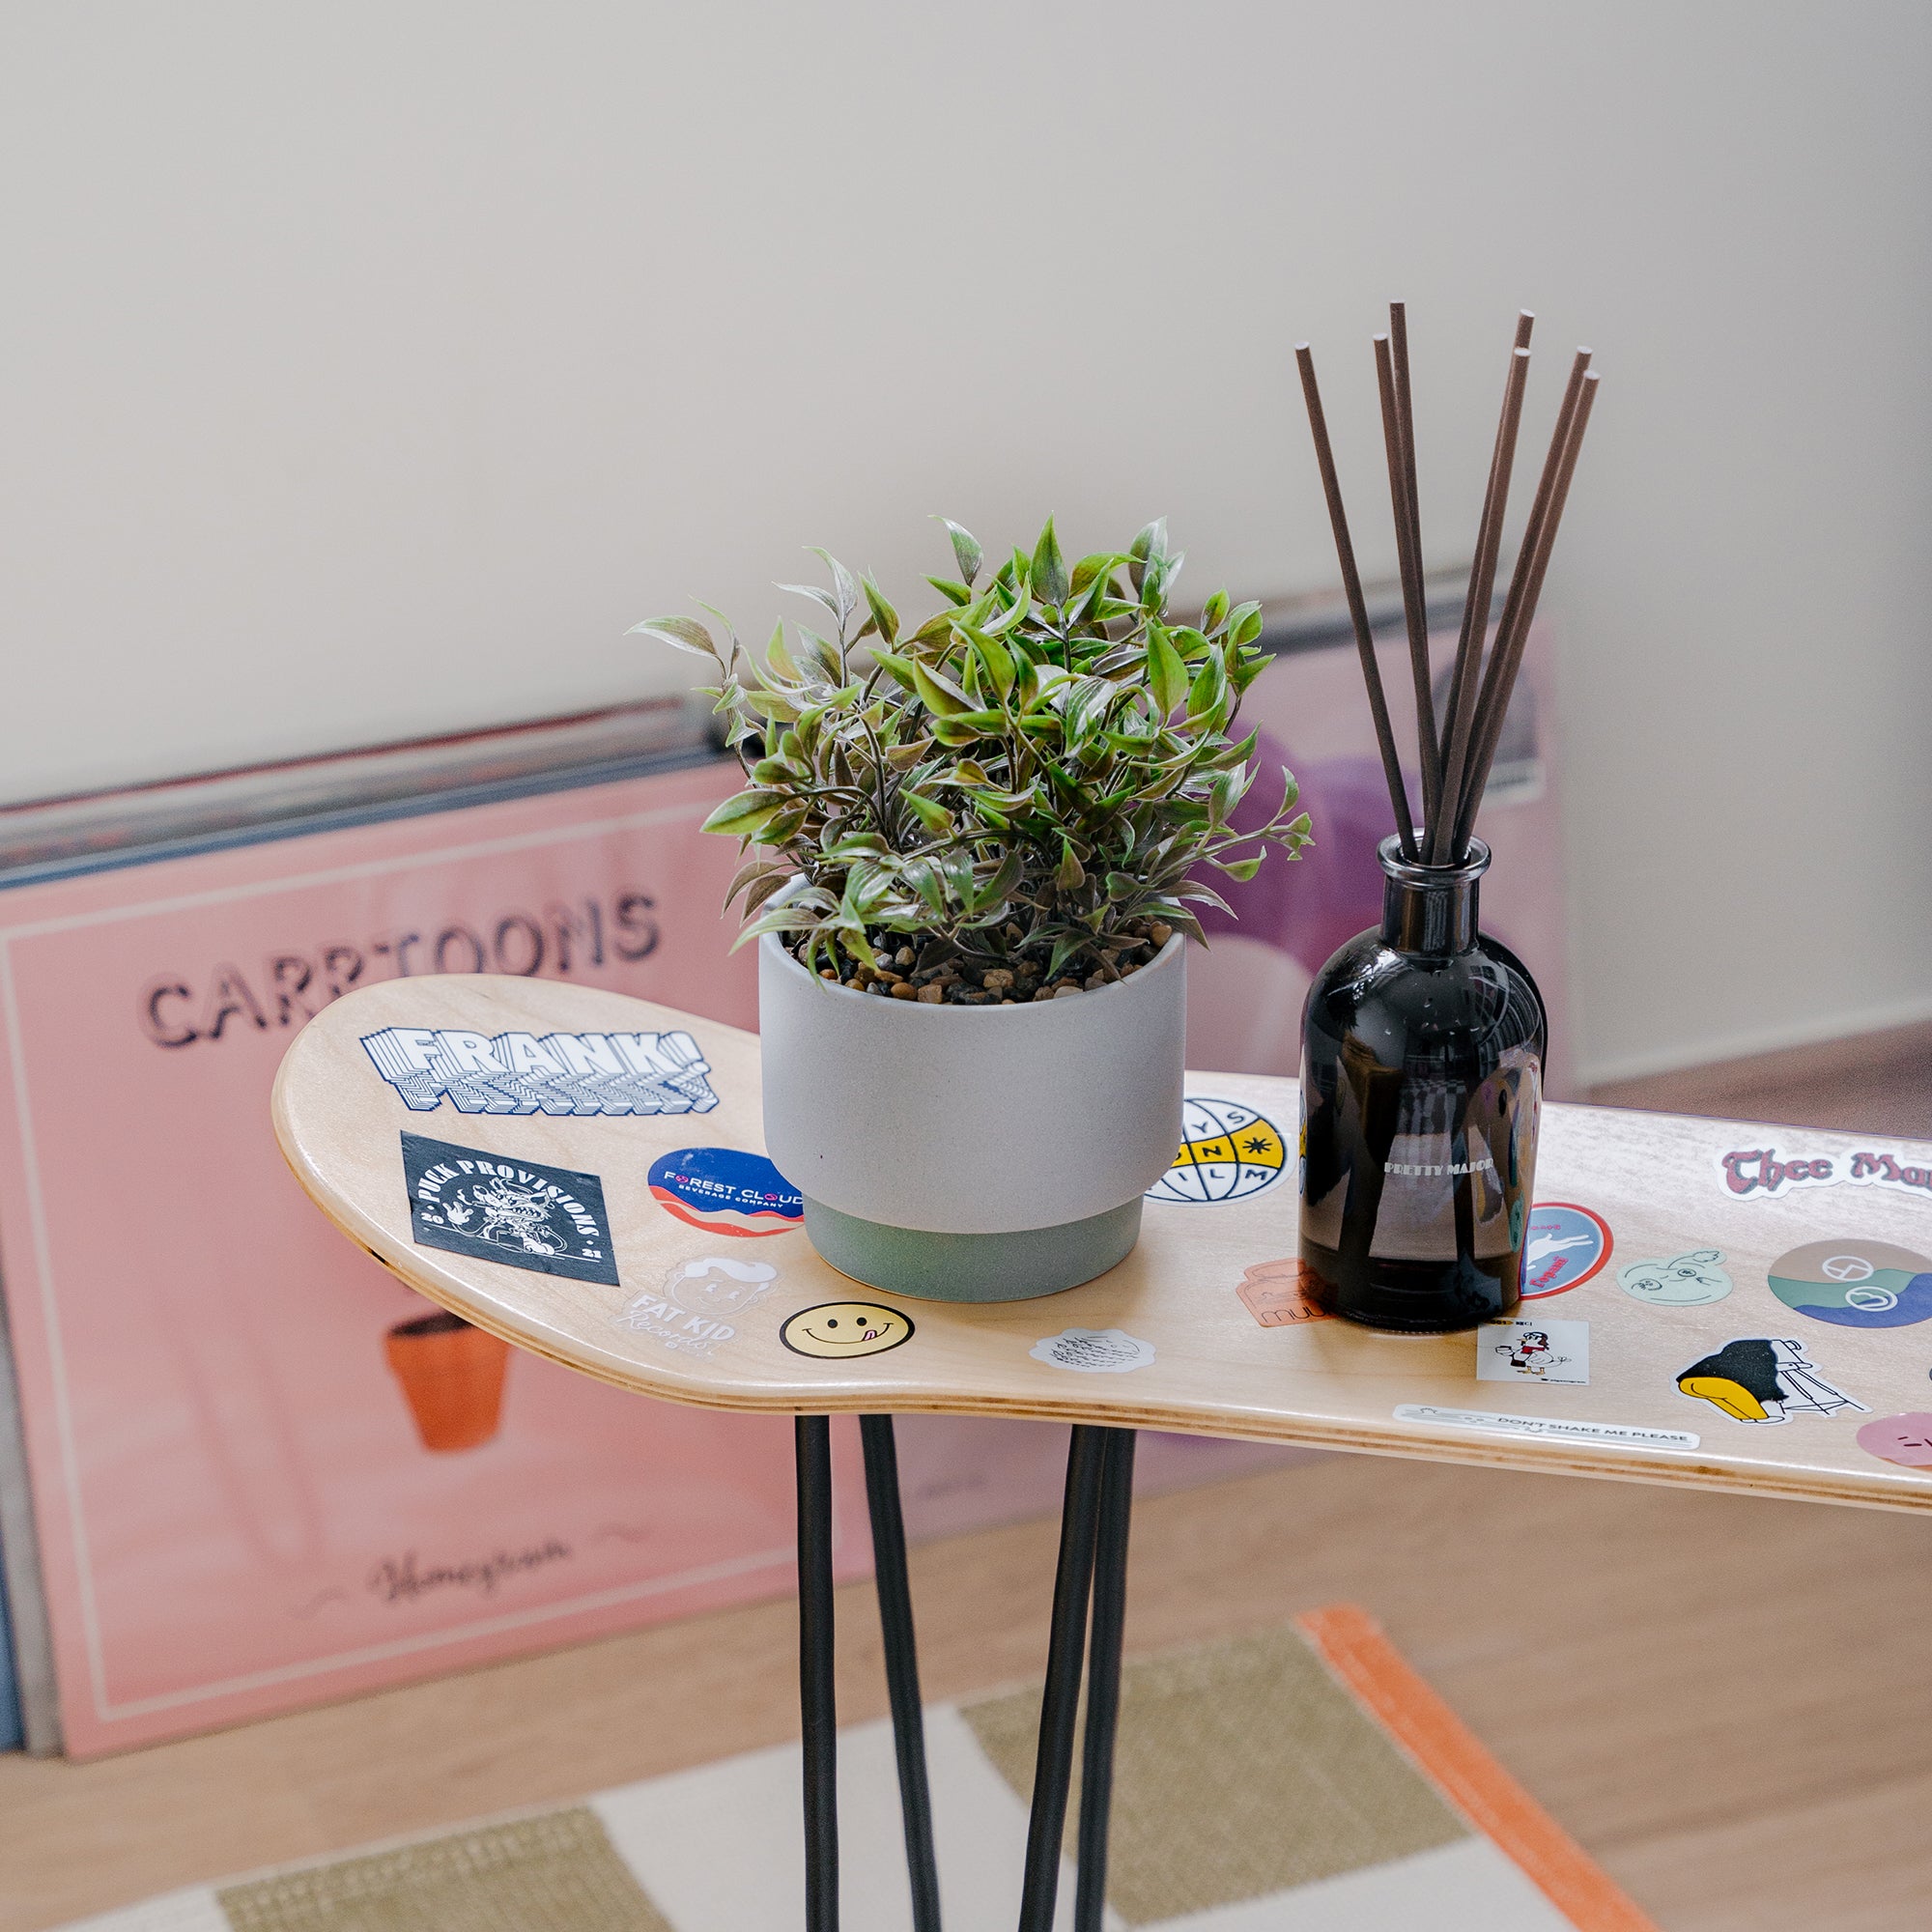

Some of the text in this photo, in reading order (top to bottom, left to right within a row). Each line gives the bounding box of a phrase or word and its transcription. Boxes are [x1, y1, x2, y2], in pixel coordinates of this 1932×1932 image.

[369, 1027, 717, 1101] FRANK!
[1191, 1111, 1245, 1134] YS
[1384, 1158, 1494, 1176] PRETTY MAJOR
[1850, 1152, 1932, 1191] Ma
[418, 1160, 600, 1236] PUCK PROVISIONS
[664, 1171, 804, 1205] FOREST CLOUD
[678, 1184, 783, 1208] BEVERAGE COMPANY
[420, 1212, 444, 1225] 20
[582, 1248, 603, 1259] 21
[632, 1294, 736, 1341] FAT KID
[1262, 1305, 1331, 1322] muu
[617, 1310, 711, 1350] Records
[1497, 1416, 1689, 1442] DON'T SHAKE ME PLEASE
